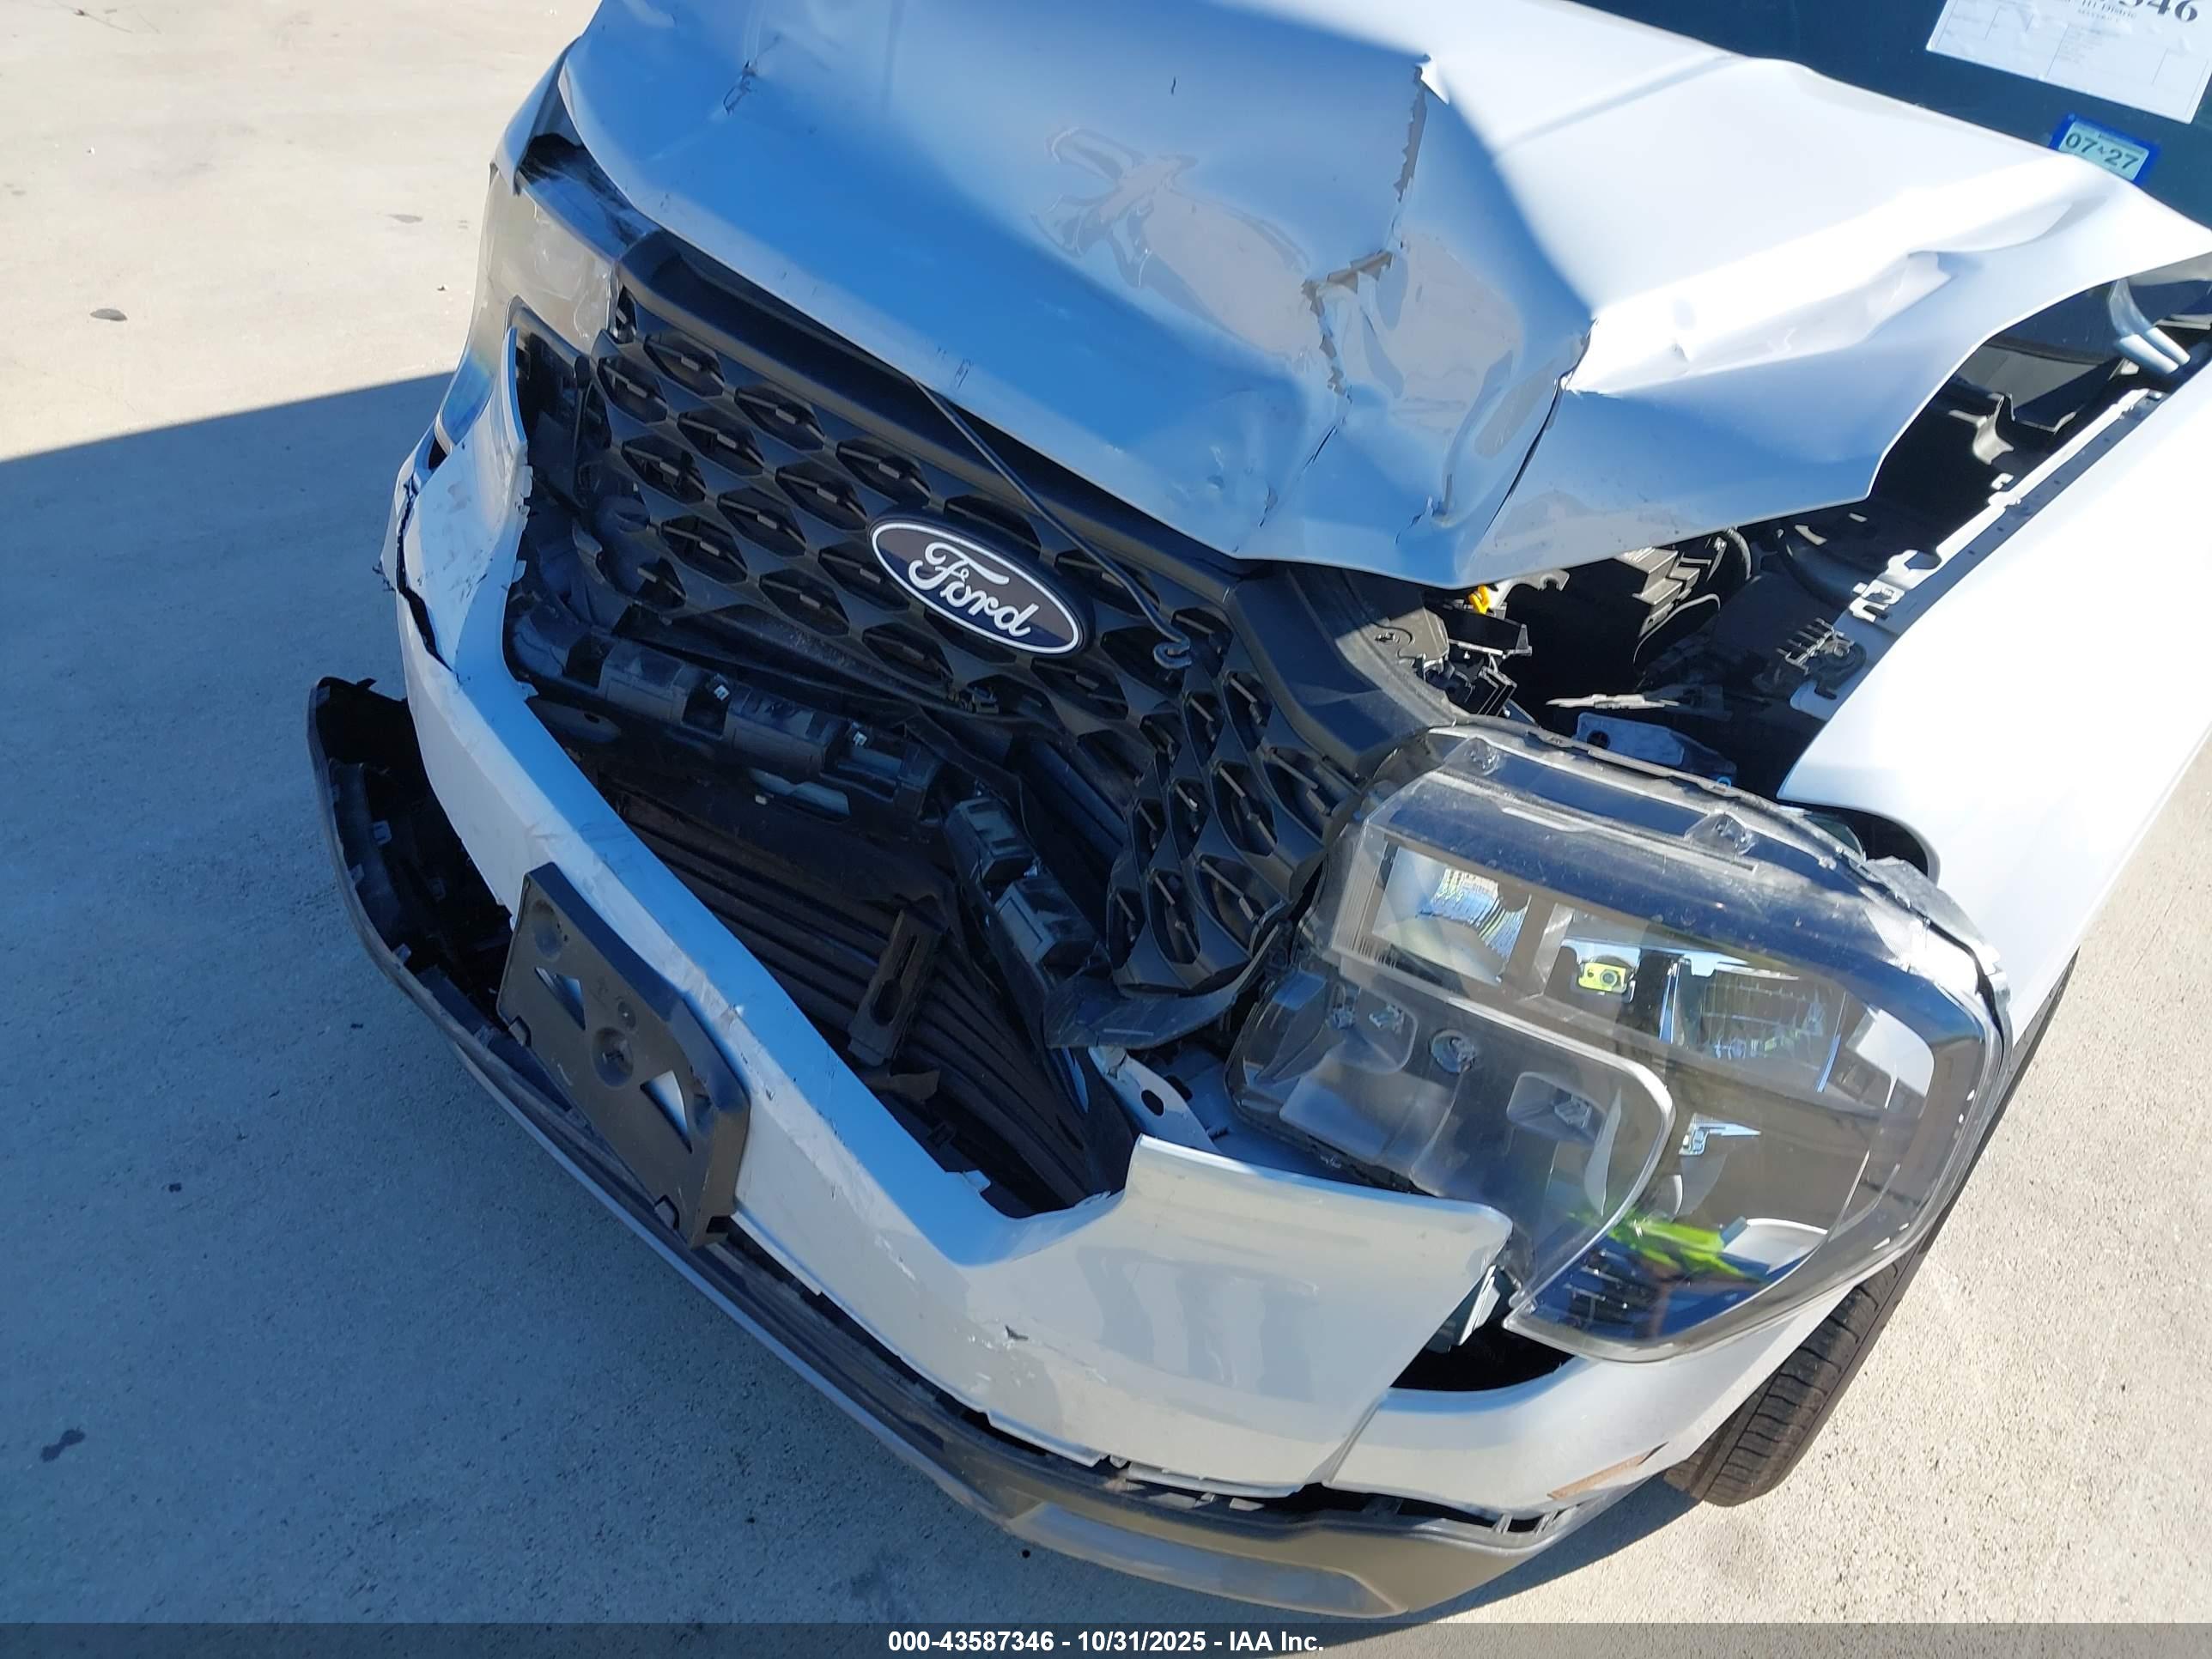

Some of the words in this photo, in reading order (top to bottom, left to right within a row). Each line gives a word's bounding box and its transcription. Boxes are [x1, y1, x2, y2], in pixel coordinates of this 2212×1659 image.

[2065, 132, 2098, 153] 07
[2104, 149, 2139, 169] 27
[908, 541, 1040, 638] Ford
